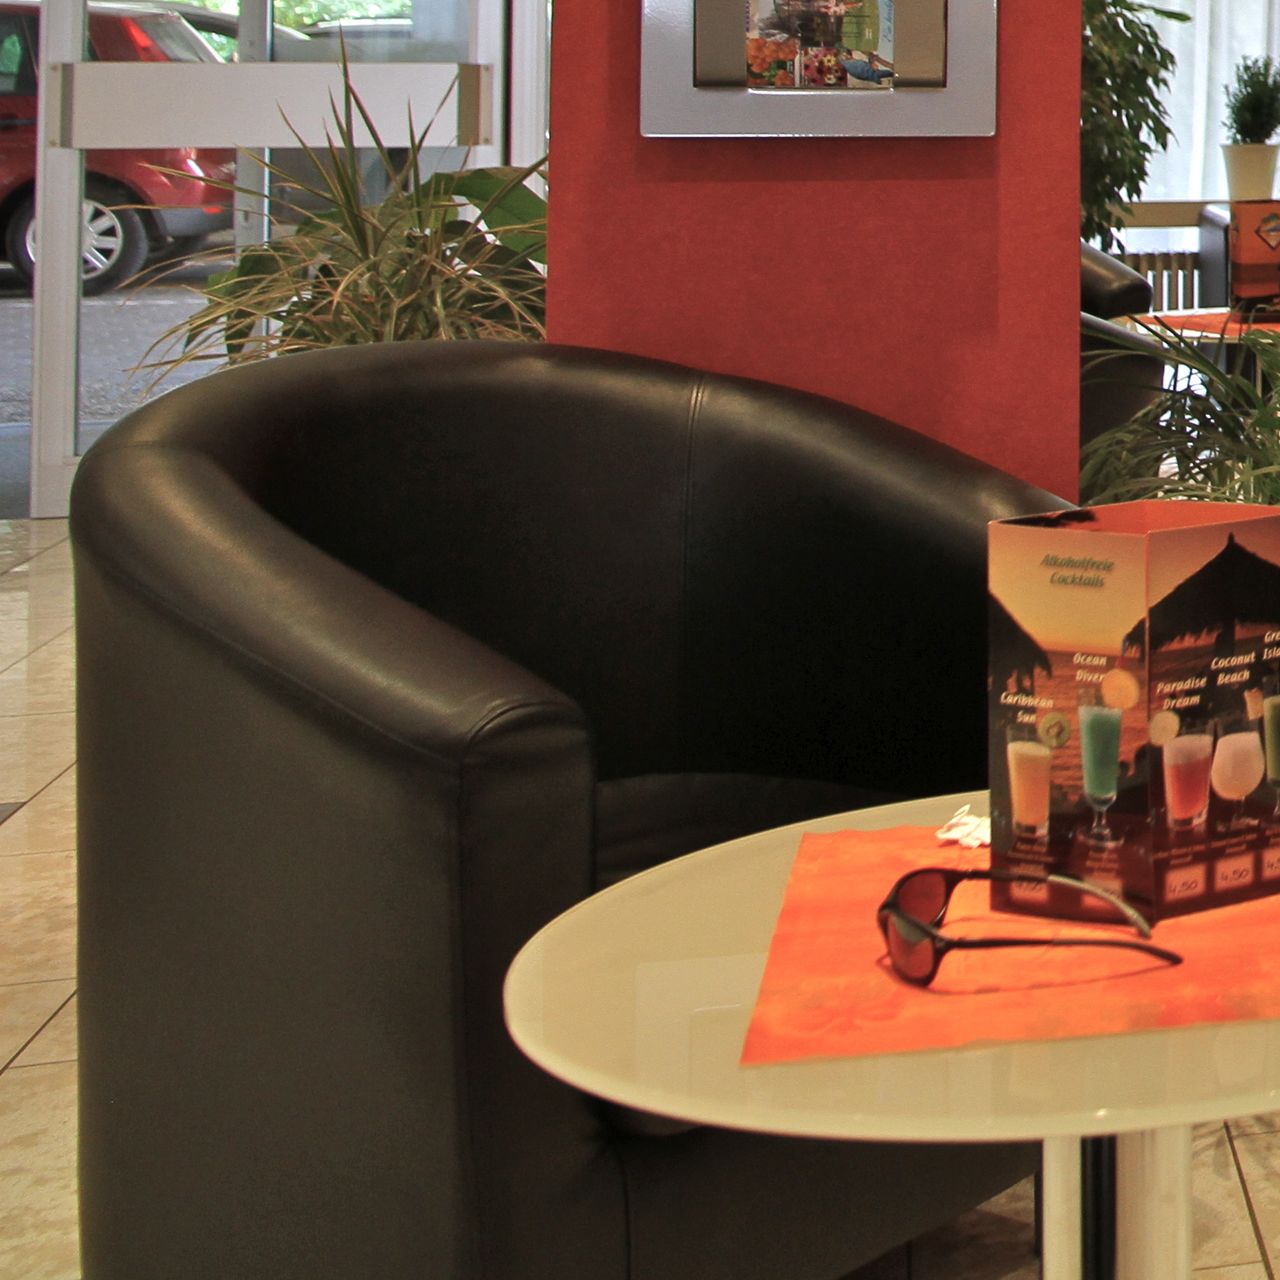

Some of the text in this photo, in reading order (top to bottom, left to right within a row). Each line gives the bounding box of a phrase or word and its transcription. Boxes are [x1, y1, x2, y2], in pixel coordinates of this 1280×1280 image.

[1050, 571, 1105, 588] Cocktails
[1073, 651, 1107, 666] Ocean
[1210, 650, 1256, 671] Coconut
[1075, 669, 1105, 682] Diver
[1217, 668, 1251, 686] Beach
[1155, 675, 1207, 696] Paradise
[1000, 691, 1054, 709] Caribbean
[1162, 694, 1200, 710] Dream
[1016, 709, 1036, 724] Sun
